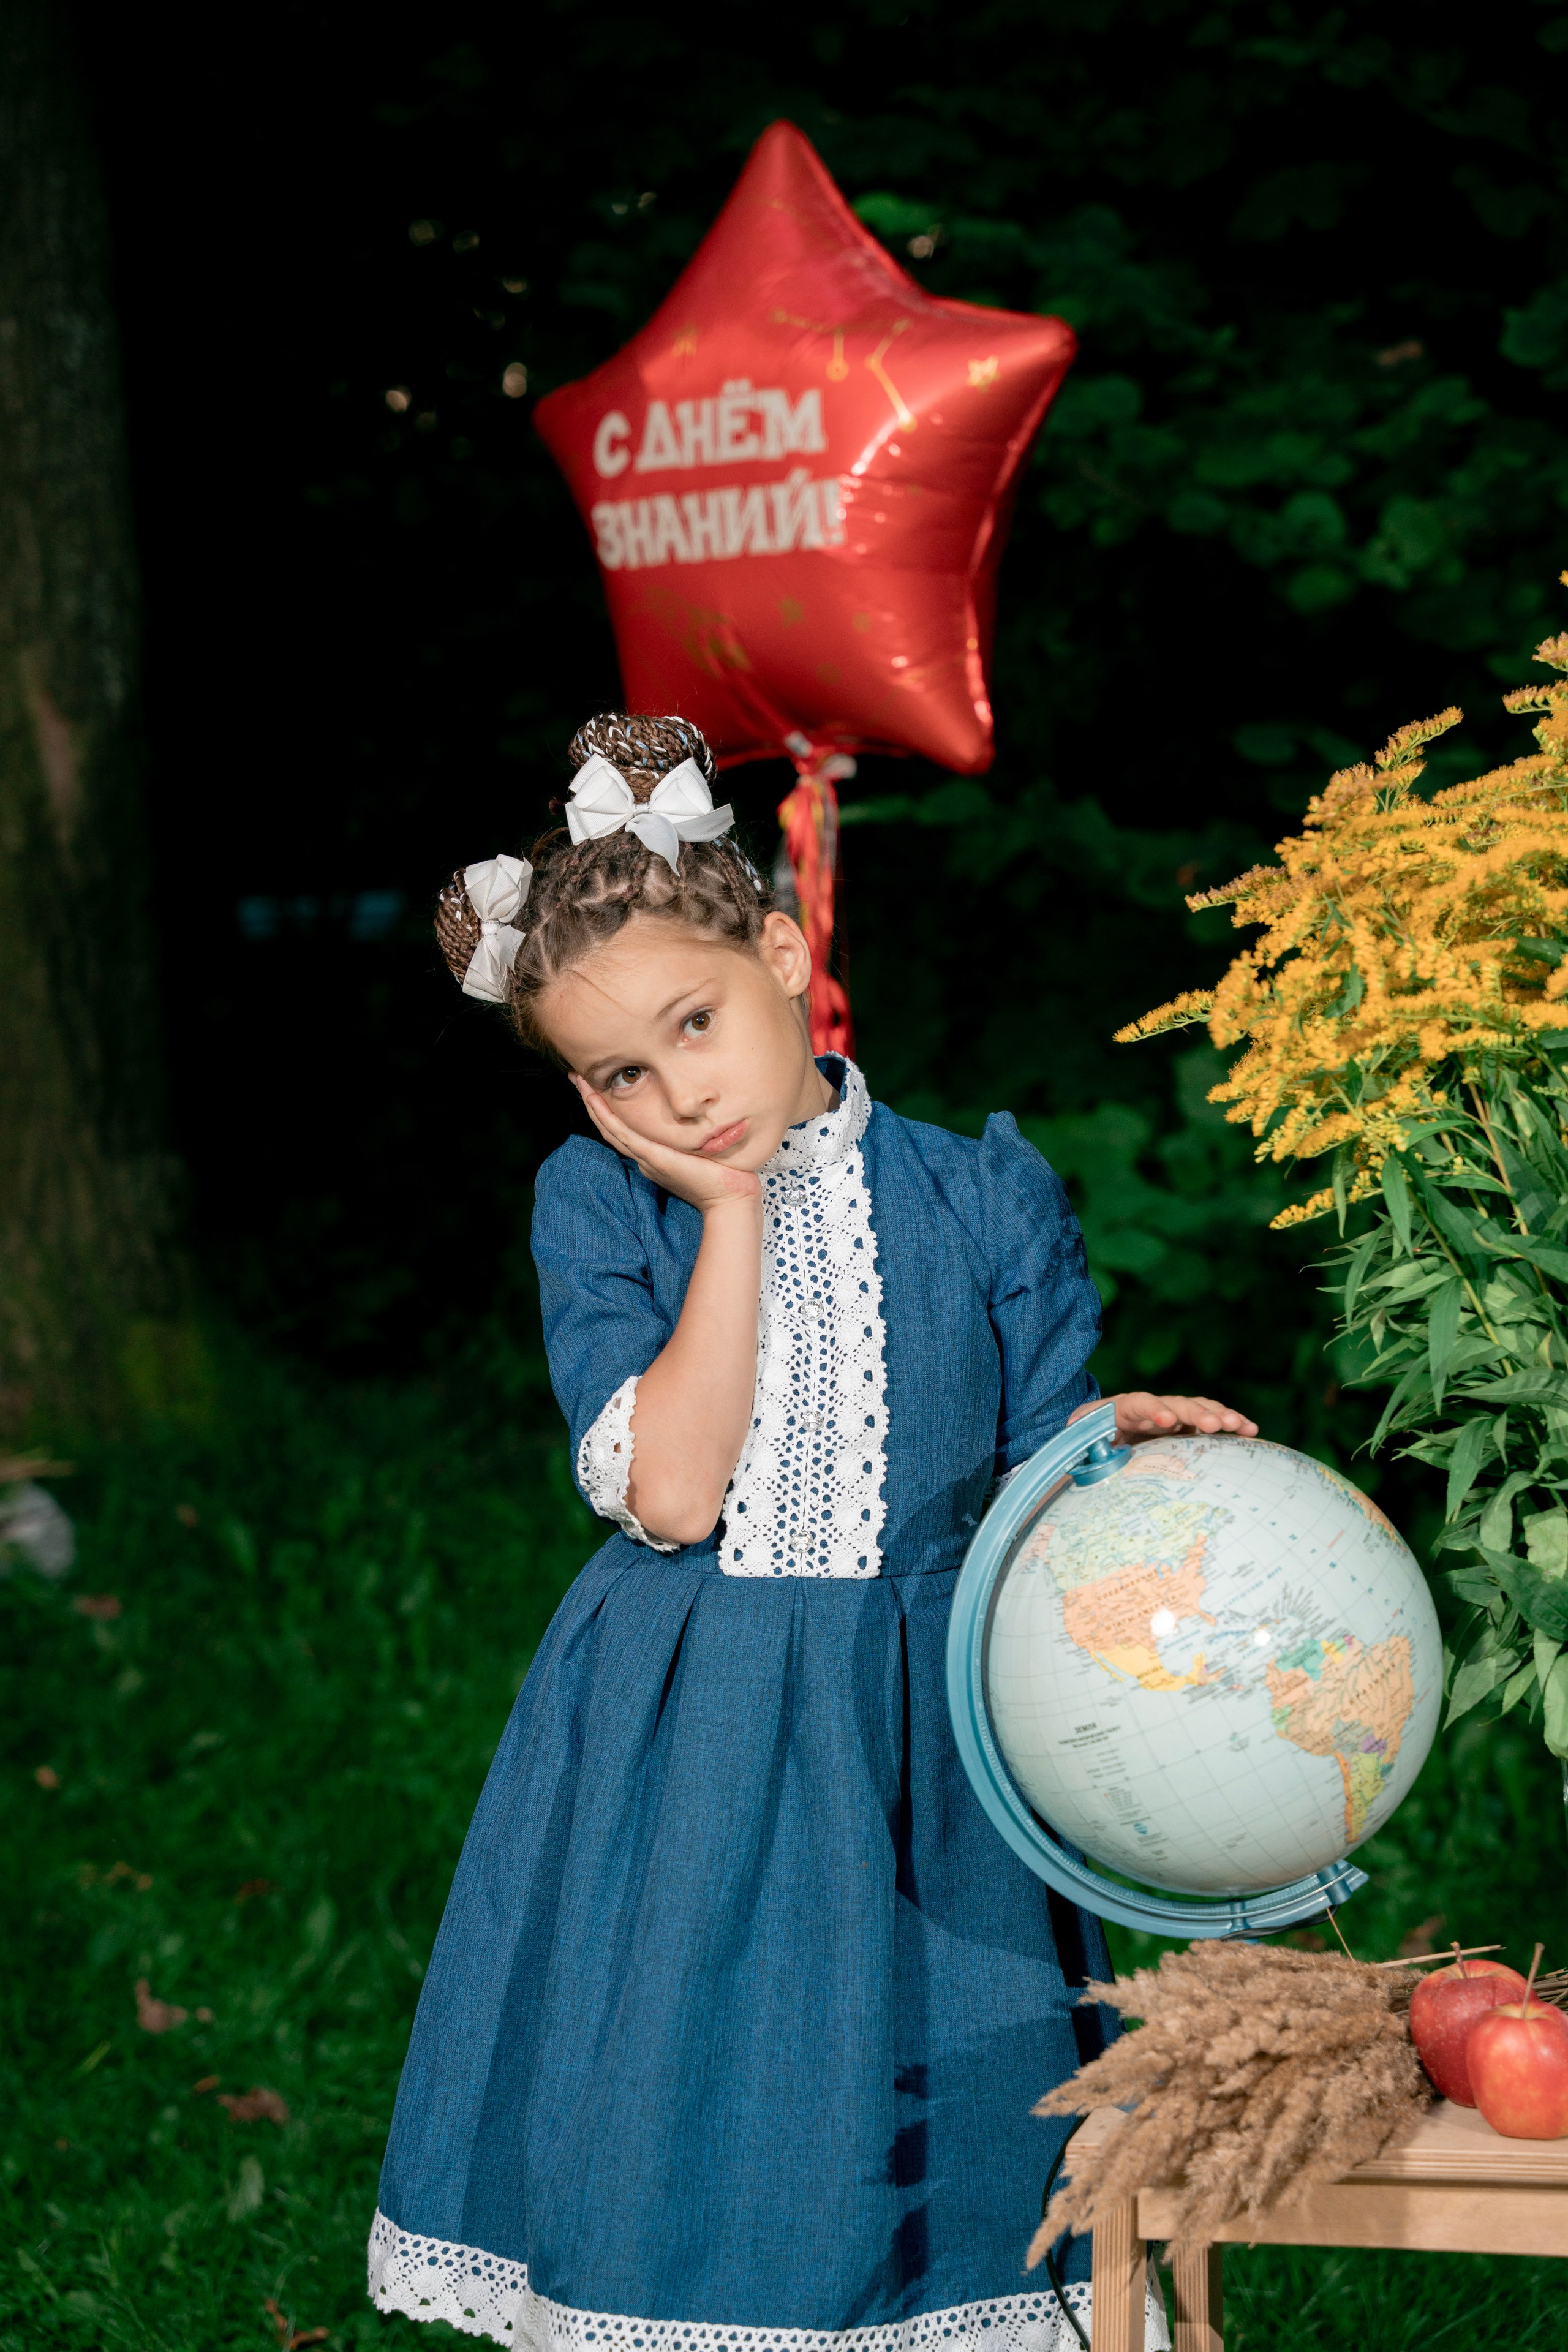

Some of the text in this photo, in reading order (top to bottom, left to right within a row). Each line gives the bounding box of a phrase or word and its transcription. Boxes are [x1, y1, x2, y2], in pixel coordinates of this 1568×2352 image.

[593, 377, 826, 478] С ДНЁМ
[590, 466, 847, 570] ЗНАНИЙ!
